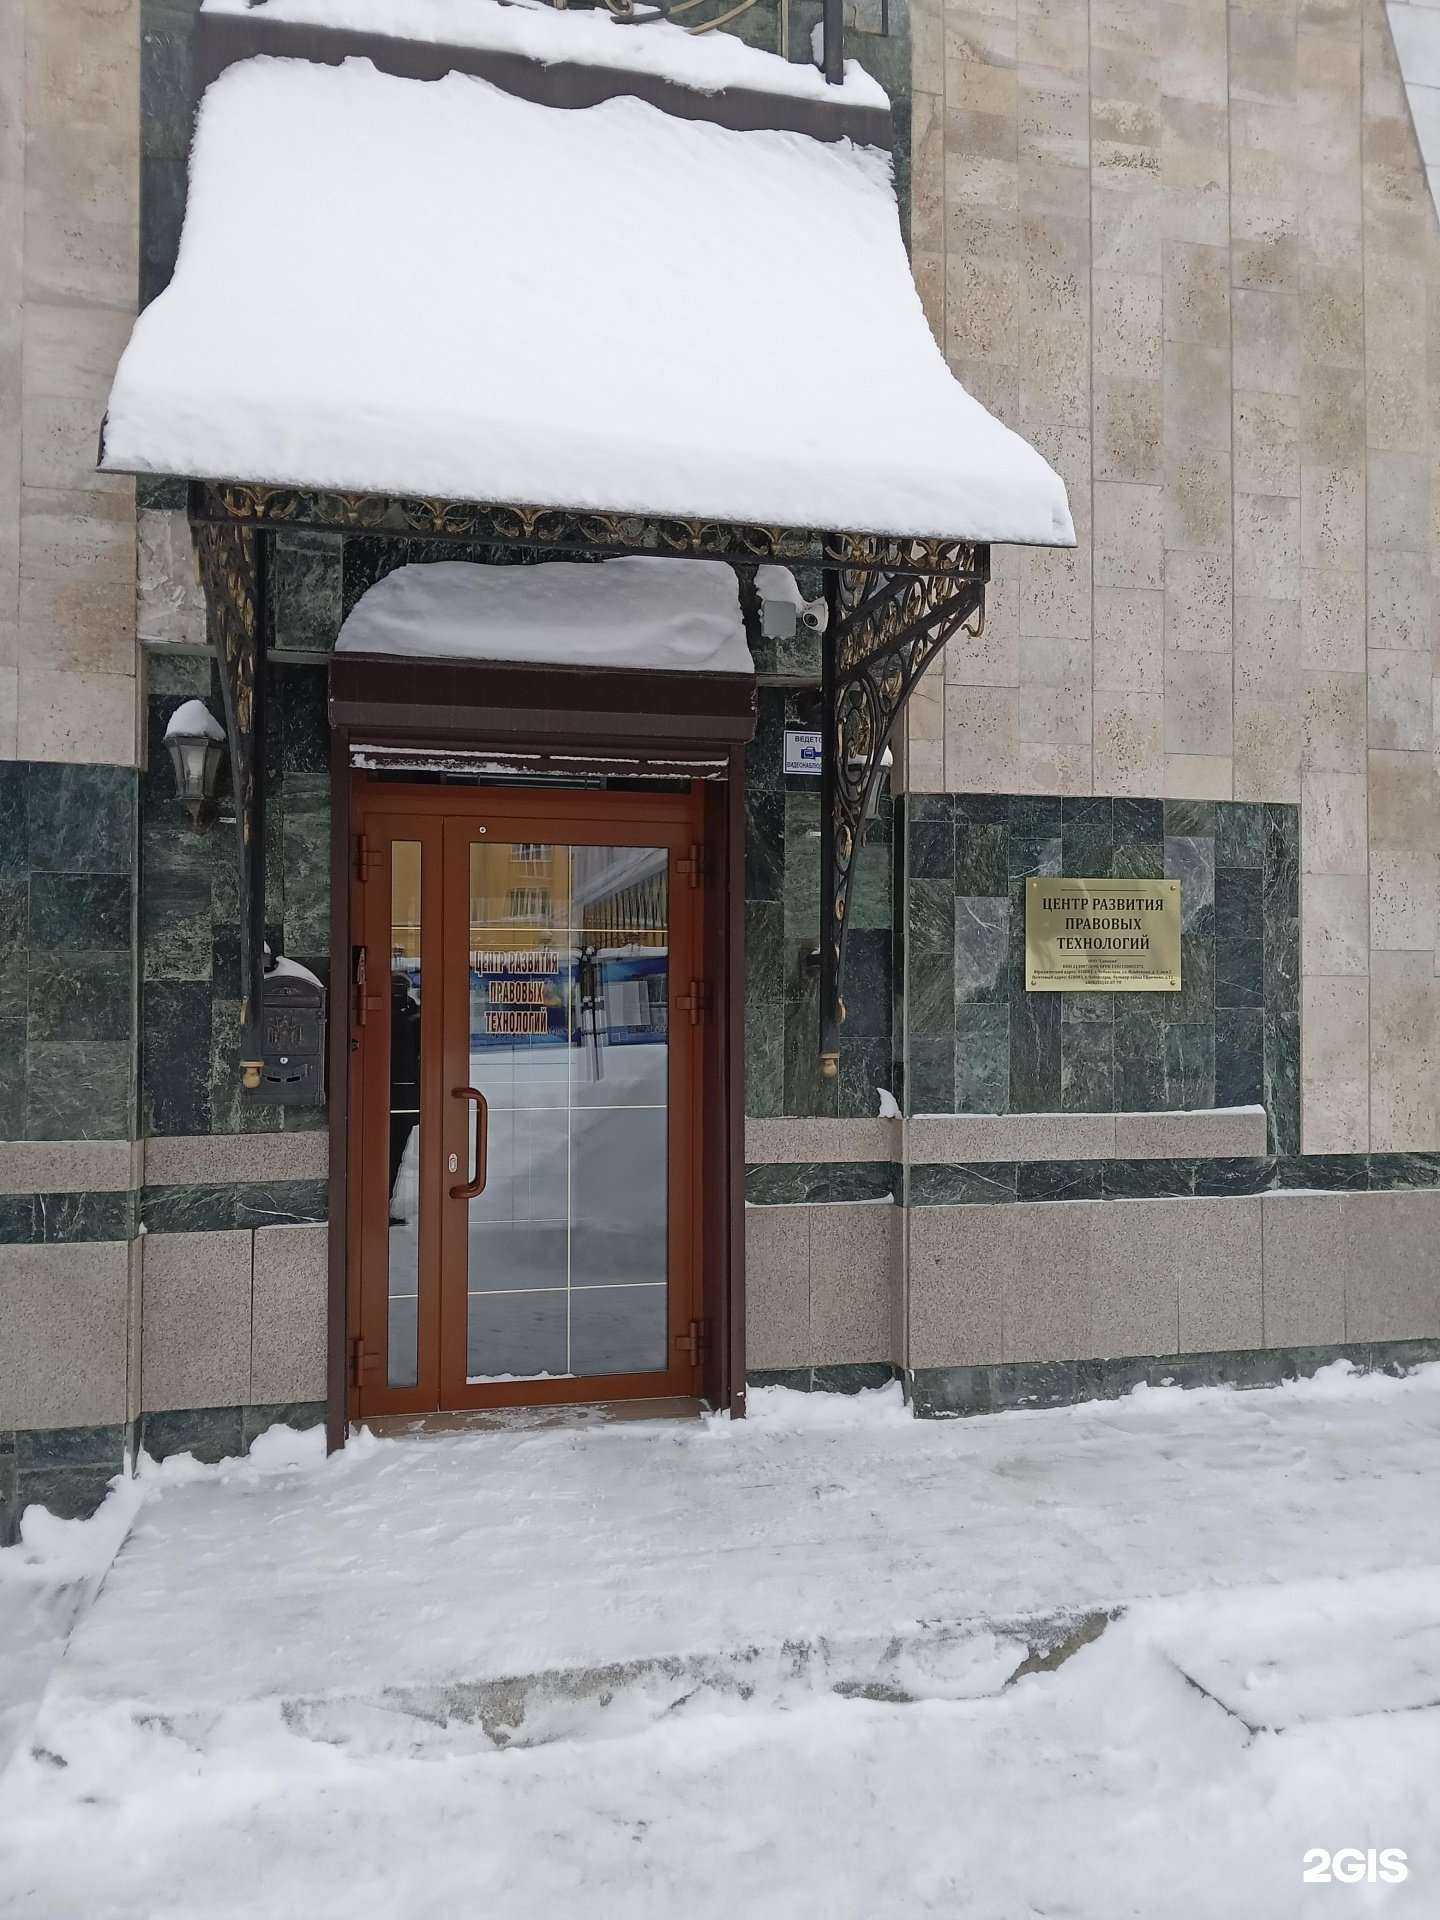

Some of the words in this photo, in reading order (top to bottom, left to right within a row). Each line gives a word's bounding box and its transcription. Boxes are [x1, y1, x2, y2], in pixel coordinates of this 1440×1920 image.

[1042, 898, 1089, 912] ЦЕНТР
[1092, 898, 1163, 911] РАЗВИТИЯ
[1065, 917, 1142, 930] ПРАВОВЫХ
[1056, 934, 1150, 950] ТЕХНОЛОГИЙ
[474, 950, 506, 977] ЦЕНТР
[508, 951, 559, 974] РАЗВИТИЯ
[488, 981, 544, 1004] ПРАВОВЫХ
[484, 1007, 548, 1034] ТЕХНОЛОГИЙ
